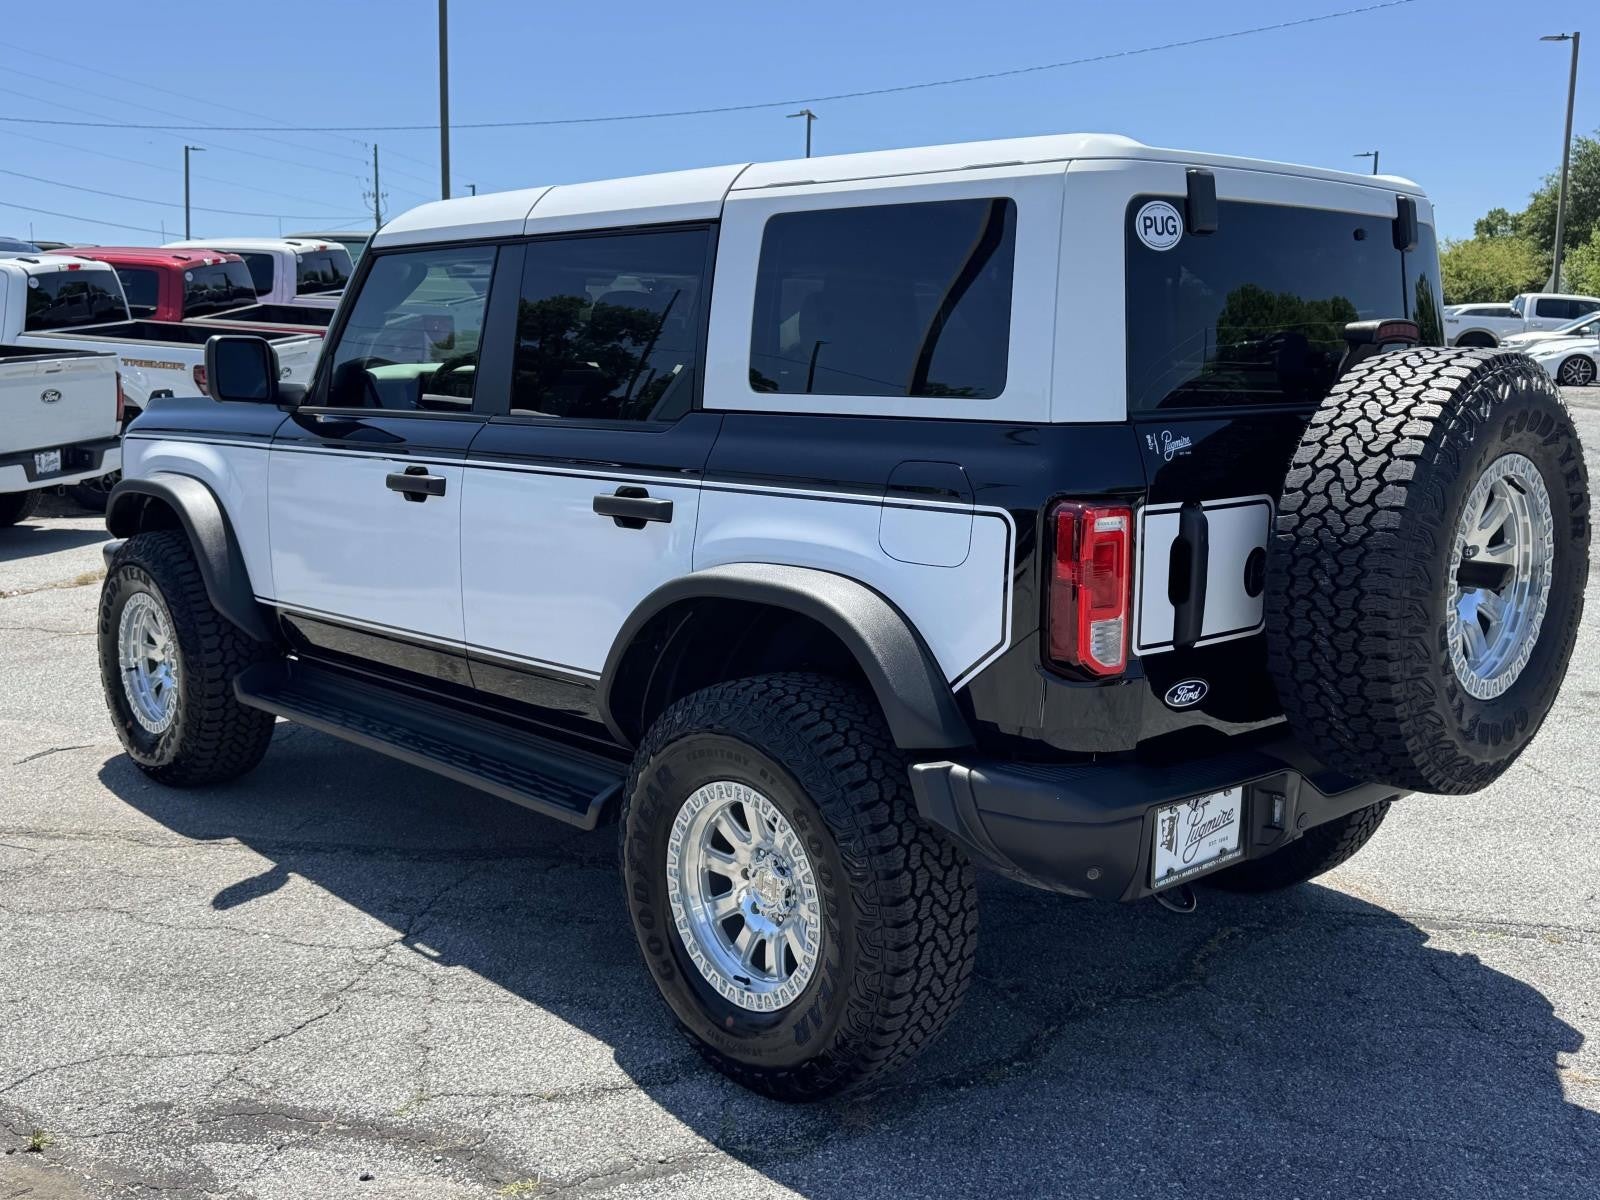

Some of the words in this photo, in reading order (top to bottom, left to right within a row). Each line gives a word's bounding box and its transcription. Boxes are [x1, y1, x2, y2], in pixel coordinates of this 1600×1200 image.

[1143, 215, 1177, 236] PUG
[121, 358, 186, 371] TREMOR
[43, 390, 61, 402] Ford
[1161, 430, 1192, 462] Pugmire
[1500, 409, 1586, 539] GOODYEAR
[101, 567, 151, 635] GOODYEAR
[1174, 684, 1201, 703] Ford
[686, 749, 750, 766] TERRITORY
[1183, 807, 1234, 864] Pugmire
[630, 765, 675, 982] GOODYEAR
